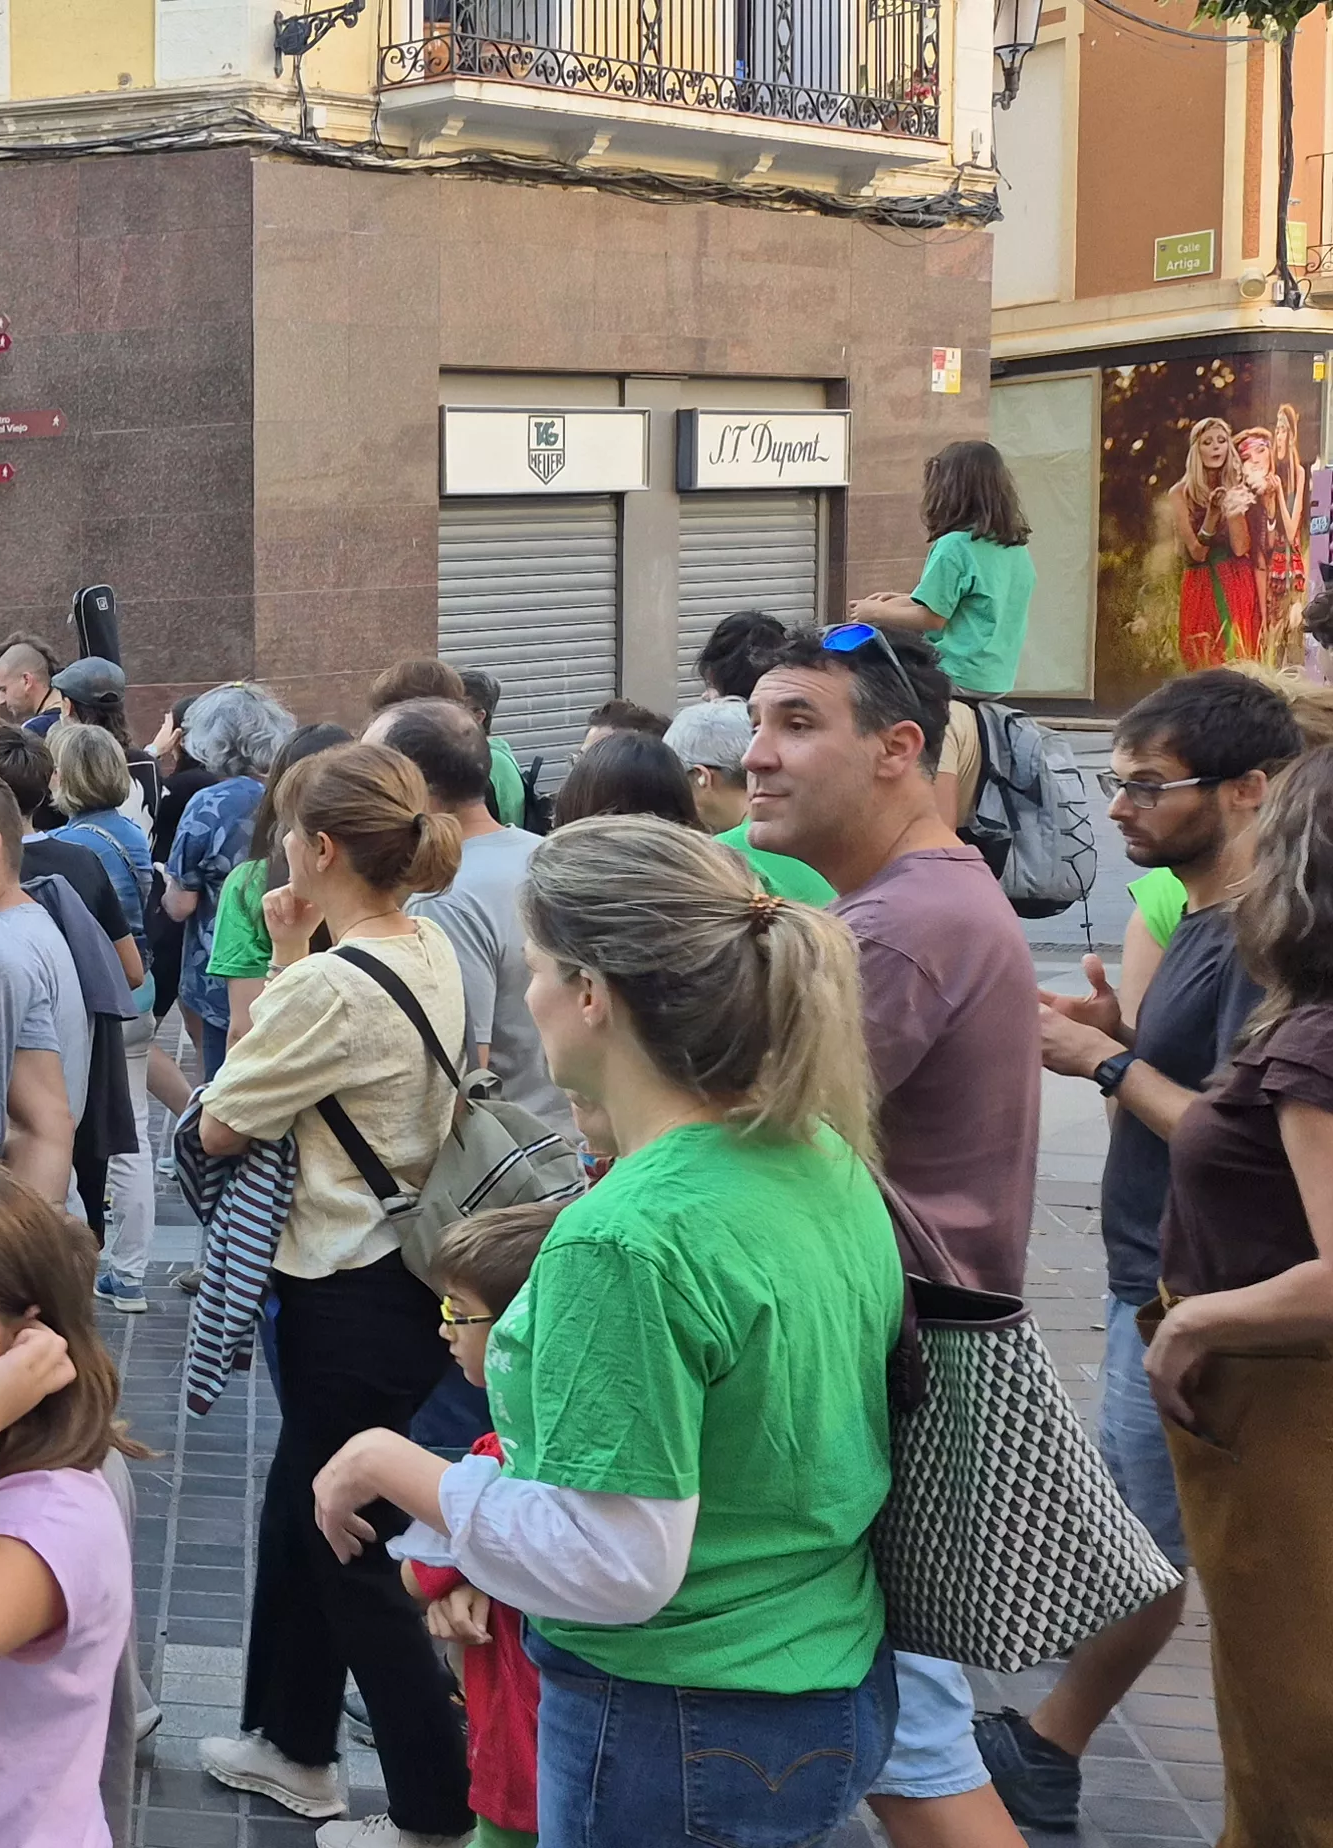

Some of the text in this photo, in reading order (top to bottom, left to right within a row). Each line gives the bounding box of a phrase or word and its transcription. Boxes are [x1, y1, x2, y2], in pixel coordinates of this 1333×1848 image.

[1177, 242, 1201, 254] Calle
[1166, 258, 1201, 272] Artiga
[6, 424, 29, 434] Viejo
[709, 420, 831, 478] S.T. Dupont
[531, 453, 563, 479] HEUER
